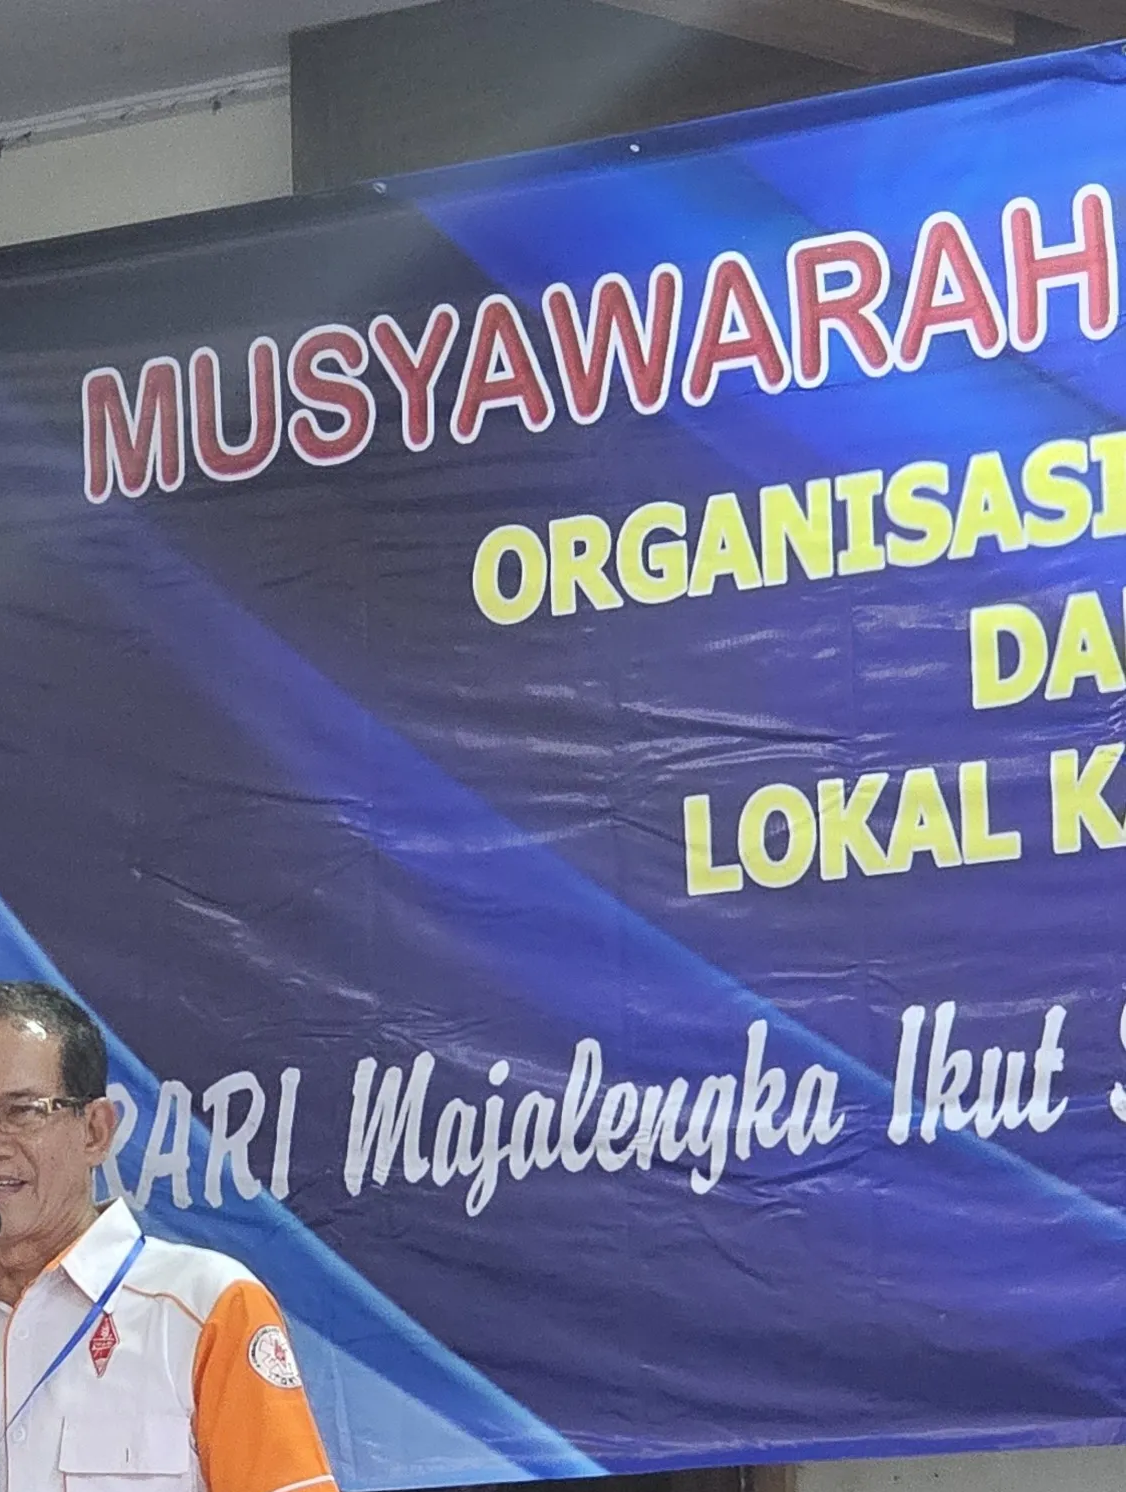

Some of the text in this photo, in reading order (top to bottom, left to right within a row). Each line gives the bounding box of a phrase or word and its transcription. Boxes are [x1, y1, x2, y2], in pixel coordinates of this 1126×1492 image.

[82, 183, 1120, 504] MUSYAWARAH
[473, 431, 1126, 625] ORGANISASI
[970, 588, 1126, 709] DA
[683, 761, 1021, 897] LOKAL
[92, 1066, 301, 1211] RARI
[344, 1019, 845, 1217] Majalengka
[886, 1000, 1069, 1144] Ikut
